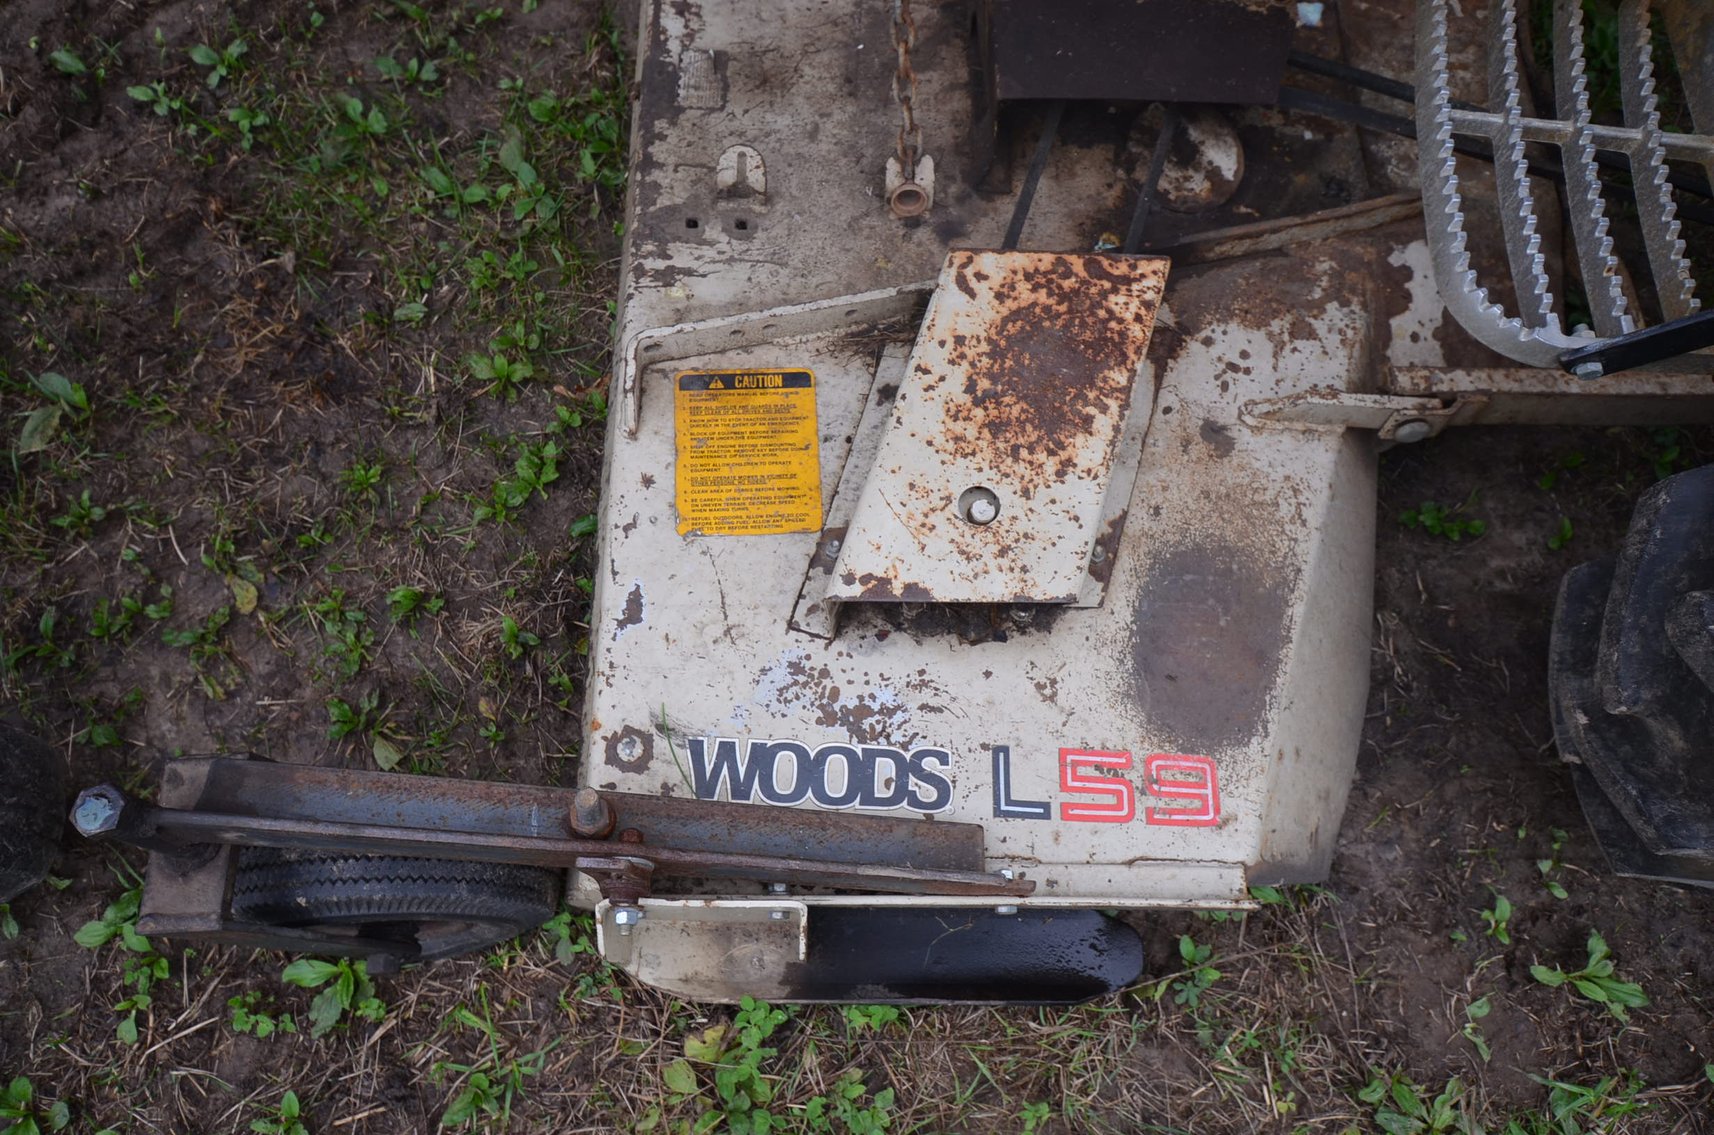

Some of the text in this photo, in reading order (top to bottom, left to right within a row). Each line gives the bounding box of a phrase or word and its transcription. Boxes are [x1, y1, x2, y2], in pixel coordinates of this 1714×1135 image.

[735, 374, 783, 388] CAUTION
[689, 738, 1222, 827] WOODS L59
